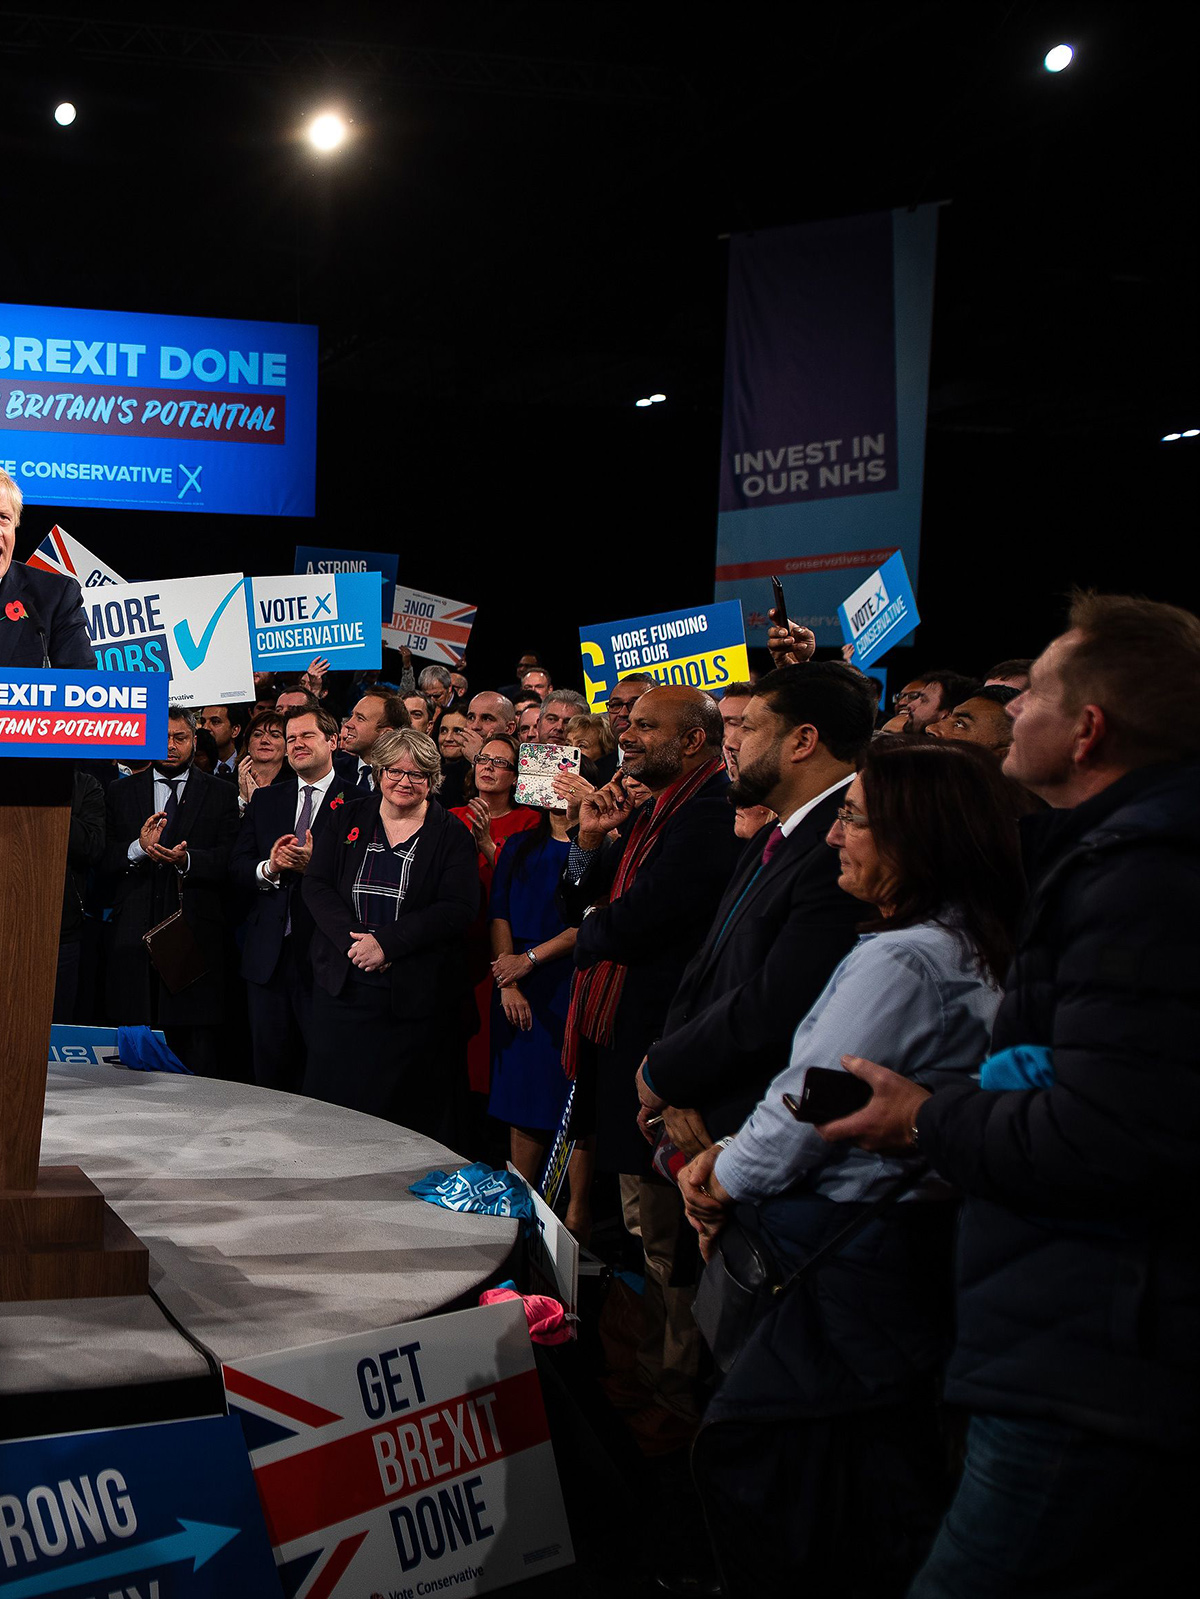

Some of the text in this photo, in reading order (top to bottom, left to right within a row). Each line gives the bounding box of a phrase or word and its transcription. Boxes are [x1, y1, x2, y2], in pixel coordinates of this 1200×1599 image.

[159, 346, 287, 387] DONE
[5, 390, 138, 424] BRITAIN'S
[141, 400, 276, 431] POTENTIAL
[21, 461, 173, 484] CONSERVATIVE
[733, 433, 886, 477] INVEST IN
[741, 458, 888, 498] OUR NHS
[306, 560, 367, 575] A STRONG
[82, 594, 166, 642] MORE
[259, 596, 309, 624] VOTE
[388, 613, 432, 635] BREXIT
[402, 599, 435, 619] DONE
[850, 597, 876, 632] VOTE
[855, 594, 907, 656] CONSERVATIVE
[256, 621, 365, 651] CONSERVATIVE
[406, 634, 428, 651] GET
[610, 614, 709, 652] MORE FUNDING
[614, 643, 670, 670] FOR OUR
[64, 685, 148, 709] DONE
[52, 719, 139, 738] POTENTIAL
[356, 1341, 426, 1420] GET
[371, 1393, 503, 1497] BREXIT
[388, 1475, 495, 1573] DONE
[389, 1563, 484, 1599] Vote Conservative
